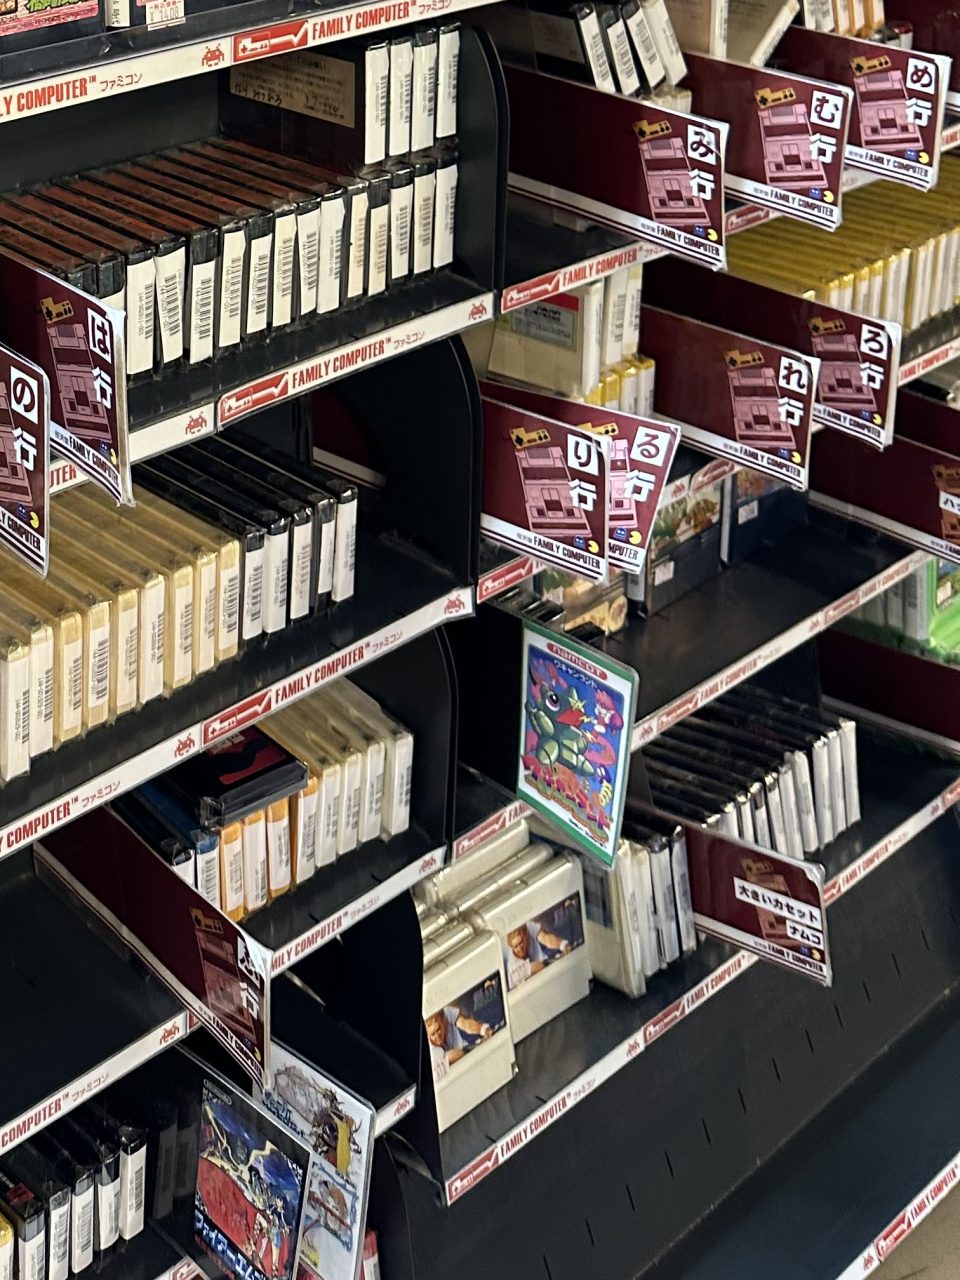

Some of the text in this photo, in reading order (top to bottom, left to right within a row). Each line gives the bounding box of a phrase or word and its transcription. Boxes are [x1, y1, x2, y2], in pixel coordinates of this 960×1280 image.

[312, 13, 352, 40] FAMILY
[100, 73, 143, 91] ファミコン
[906, 63, 933, 127] め行
[809, 95, 839, 163] む行
[90, 315, 113, 409] は行
[292, 331, 425, 388] FAMILY ファミコン
[860, 329, 884, 390] ろ行
[12, 376, 37, 471] の行
[778, 361, 806, 427] れ行
[569, 440, 597, 512] り行
[624, 432, 661, 503] る行
[275, 630, 403, 703] FAMILY ファミコン
[81, 779, 121, 808] ファミコン
[740, 883, 820, 923] 大きいカセット
[789, 923, 821, 946] ナムコ
[72, 1073, 109, 1102] ファミコン
